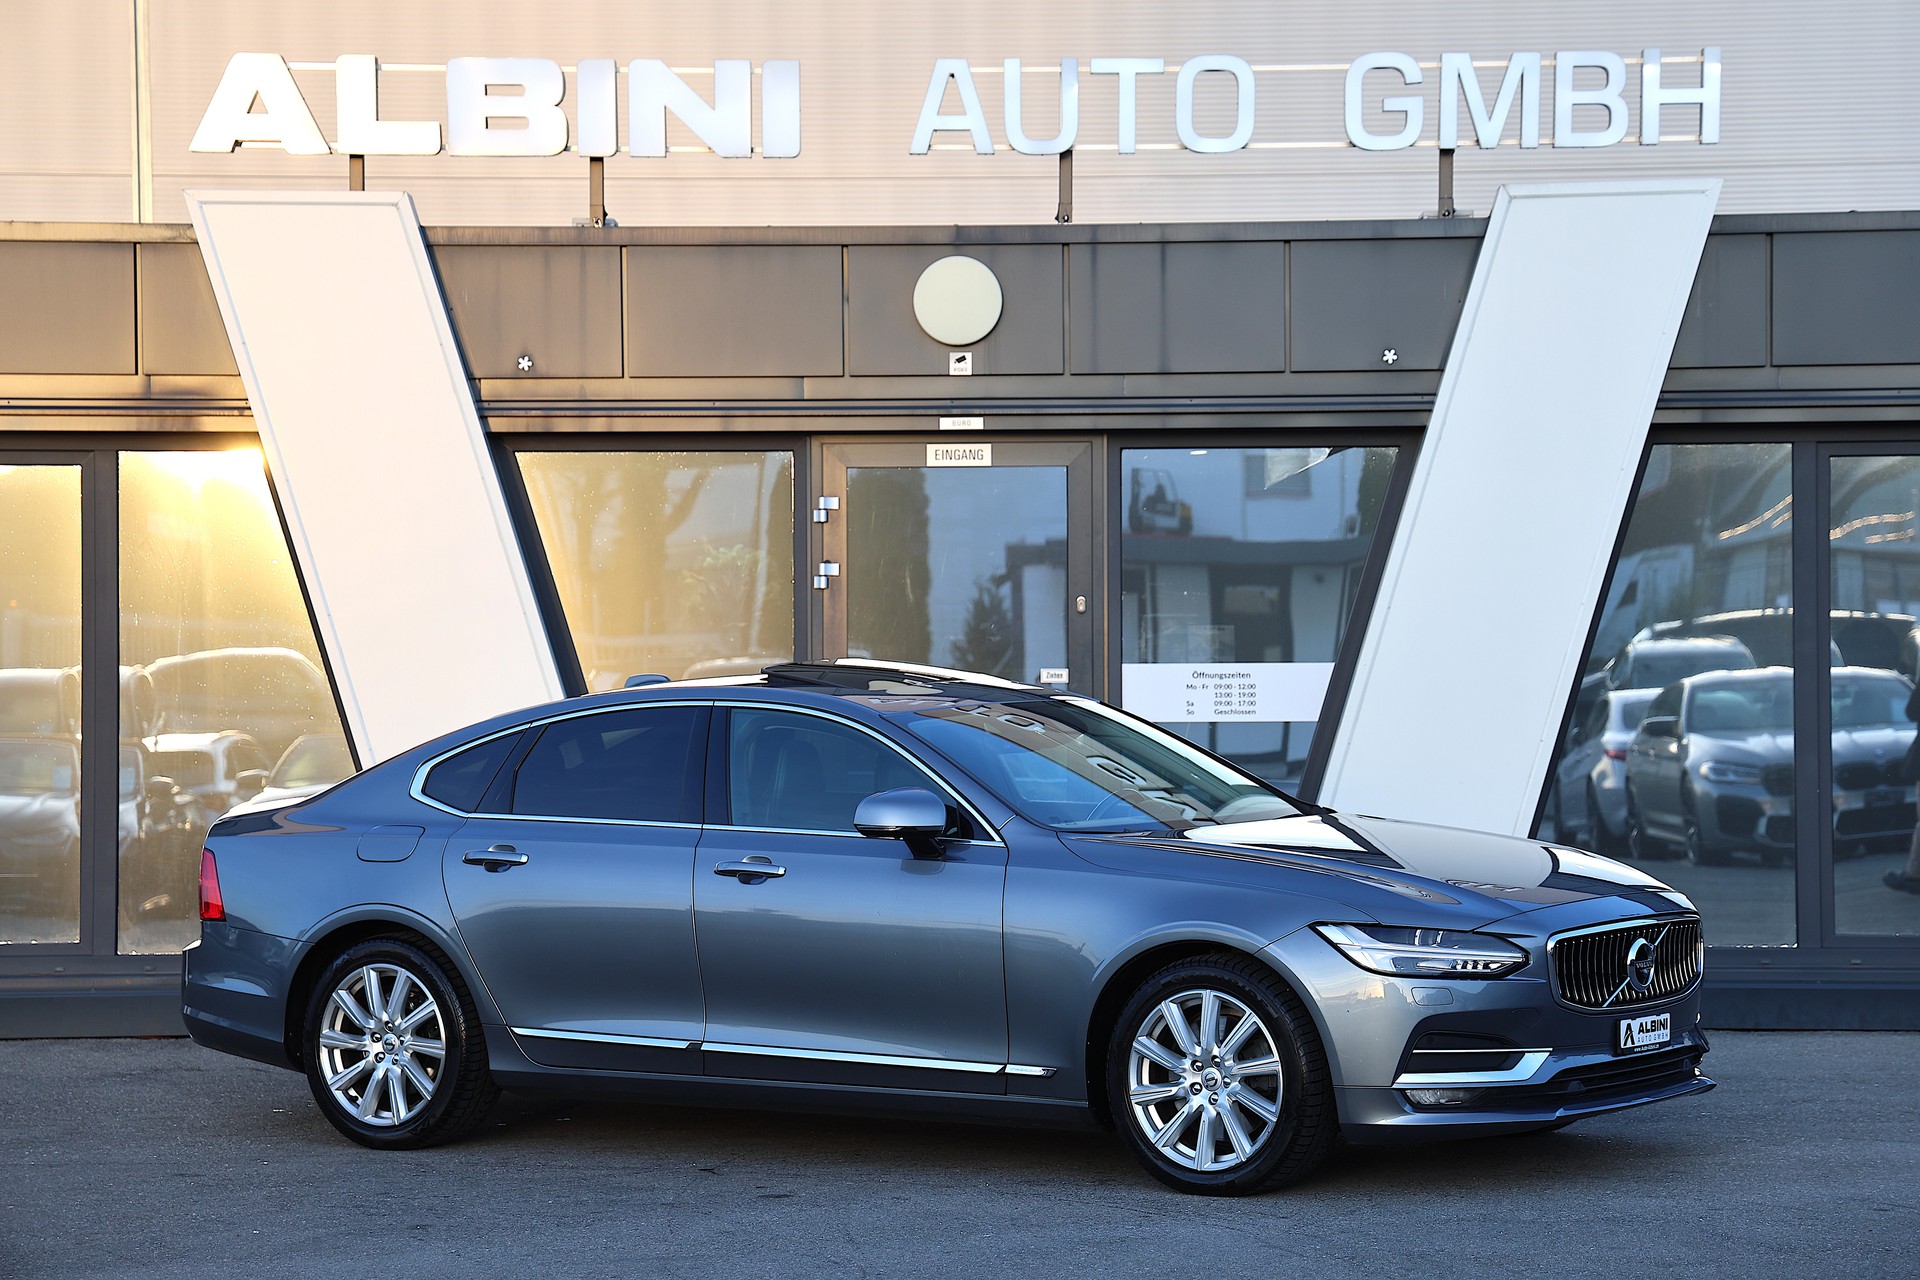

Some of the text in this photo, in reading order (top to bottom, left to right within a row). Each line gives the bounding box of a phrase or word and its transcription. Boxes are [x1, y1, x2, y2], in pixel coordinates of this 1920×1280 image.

[188, 46, 1722, 158] ALBINI AUTO GMBH
[934, 449, 984, 461] EINGANG
[1192, 671, 1251, 680] Öffnungszeiten
[1638, 1018, 1668, 1034] ALBINI
[1637, 1035, 1652, 1043] AUTO
